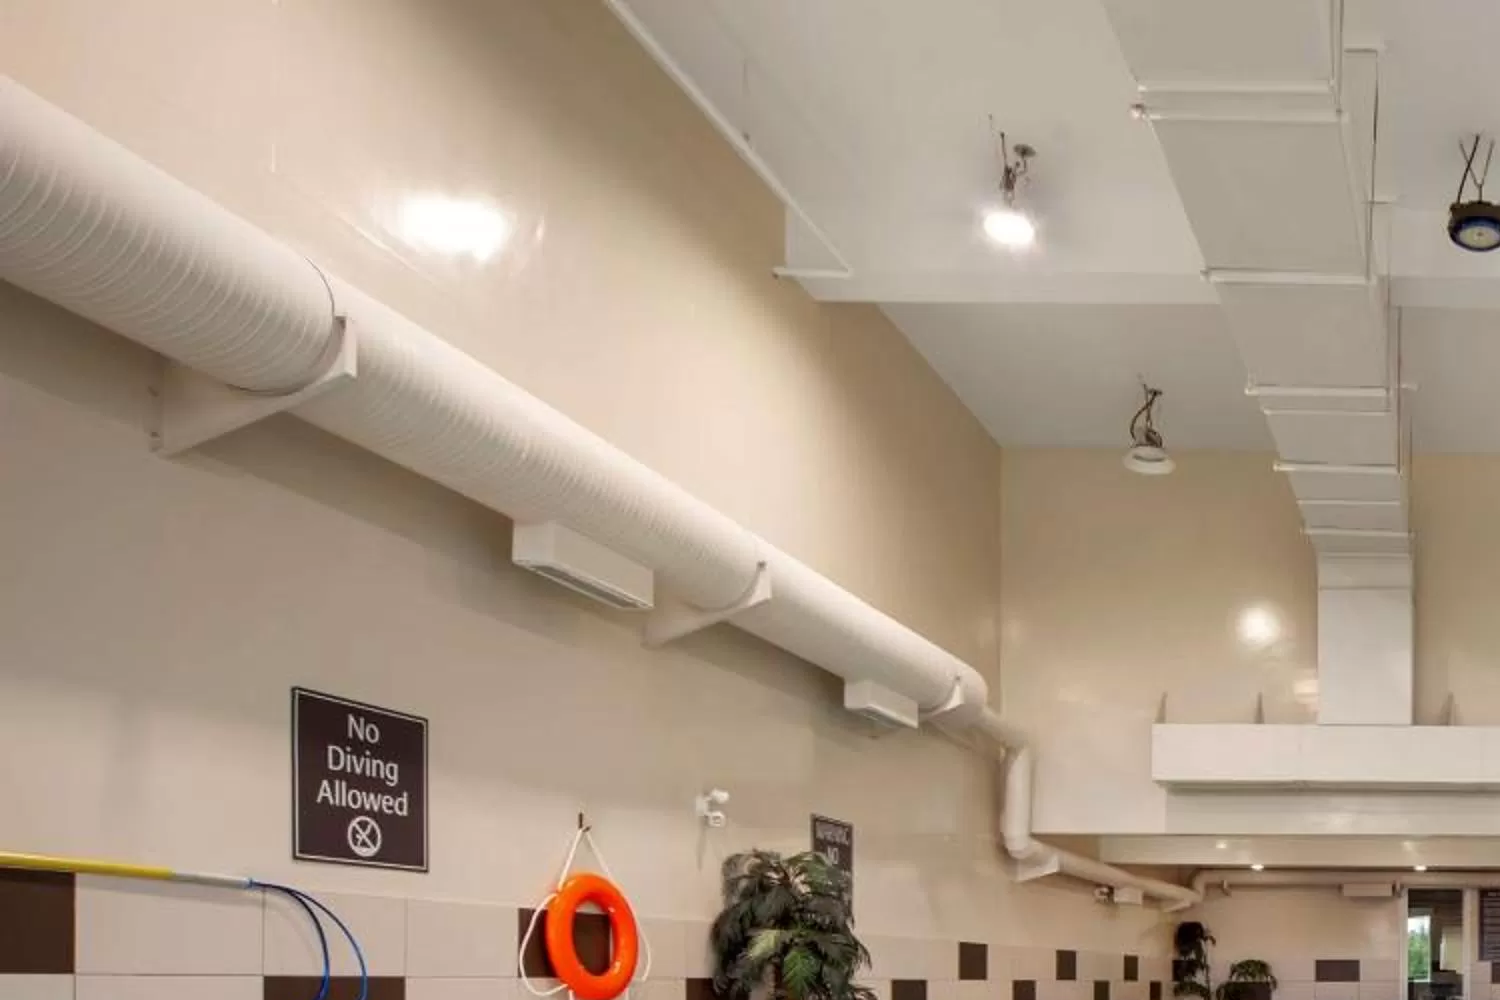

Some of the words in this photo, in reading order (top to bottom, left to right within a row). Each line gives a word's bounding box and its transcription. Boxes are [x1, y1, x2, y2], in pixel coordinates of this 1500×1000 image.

[347, 713, 380, 744] No
[327, 745, 399, 787] Diving
[316, 779, 409, 816] Allowed
